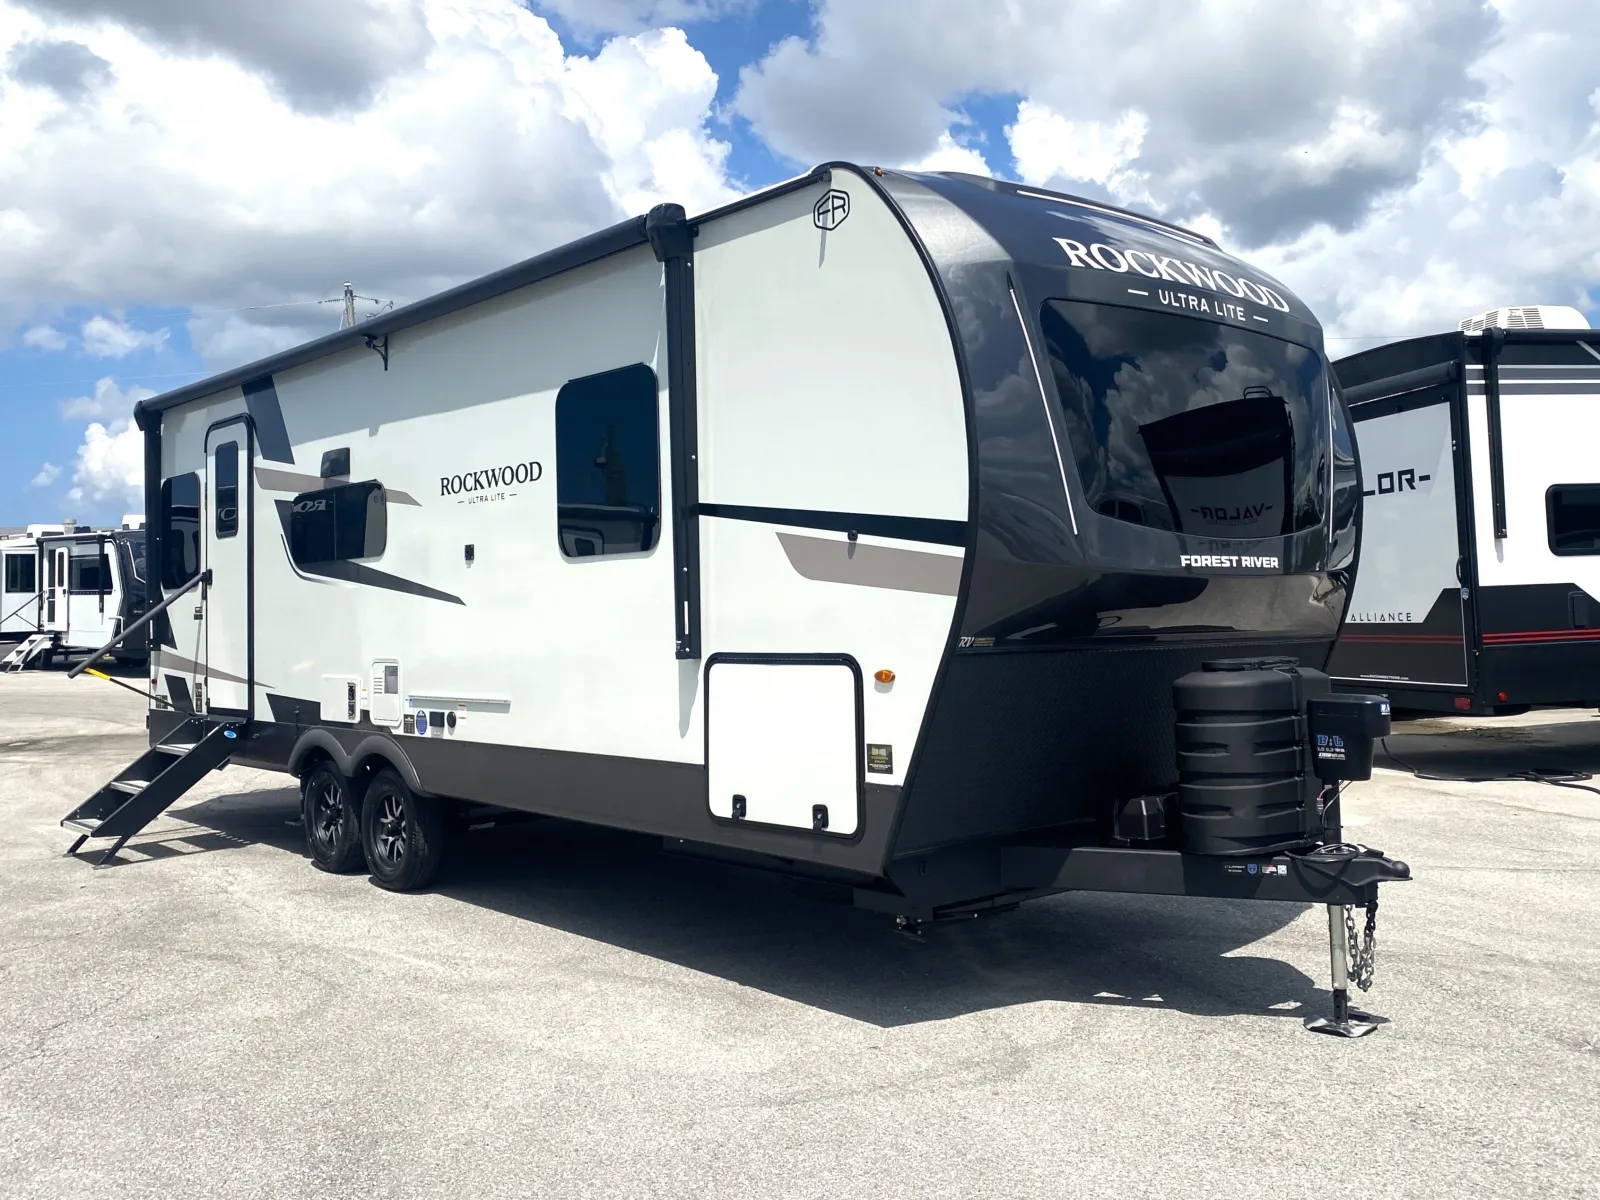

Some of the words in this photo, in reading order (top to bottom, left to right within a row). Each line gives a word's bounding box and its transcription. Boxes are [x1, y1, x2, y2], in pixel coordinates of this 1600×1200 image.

[1052, 237, 1290, 313] ROCKWOOD
[1158, 289, 1210, 314] ULTRA
[1214, 303, 1246, 322] LITE
[440, 461, 543, 496] ROCKWOOD
[467, 495, 489, 504] ULTRA
[490, 493, 506, 501] LITE
[1179, 555, 1239, 568] FOREST
[1240, 556, 1280, 568] RIVER
[1350, 612, 1412, 622] ALLIANCE
